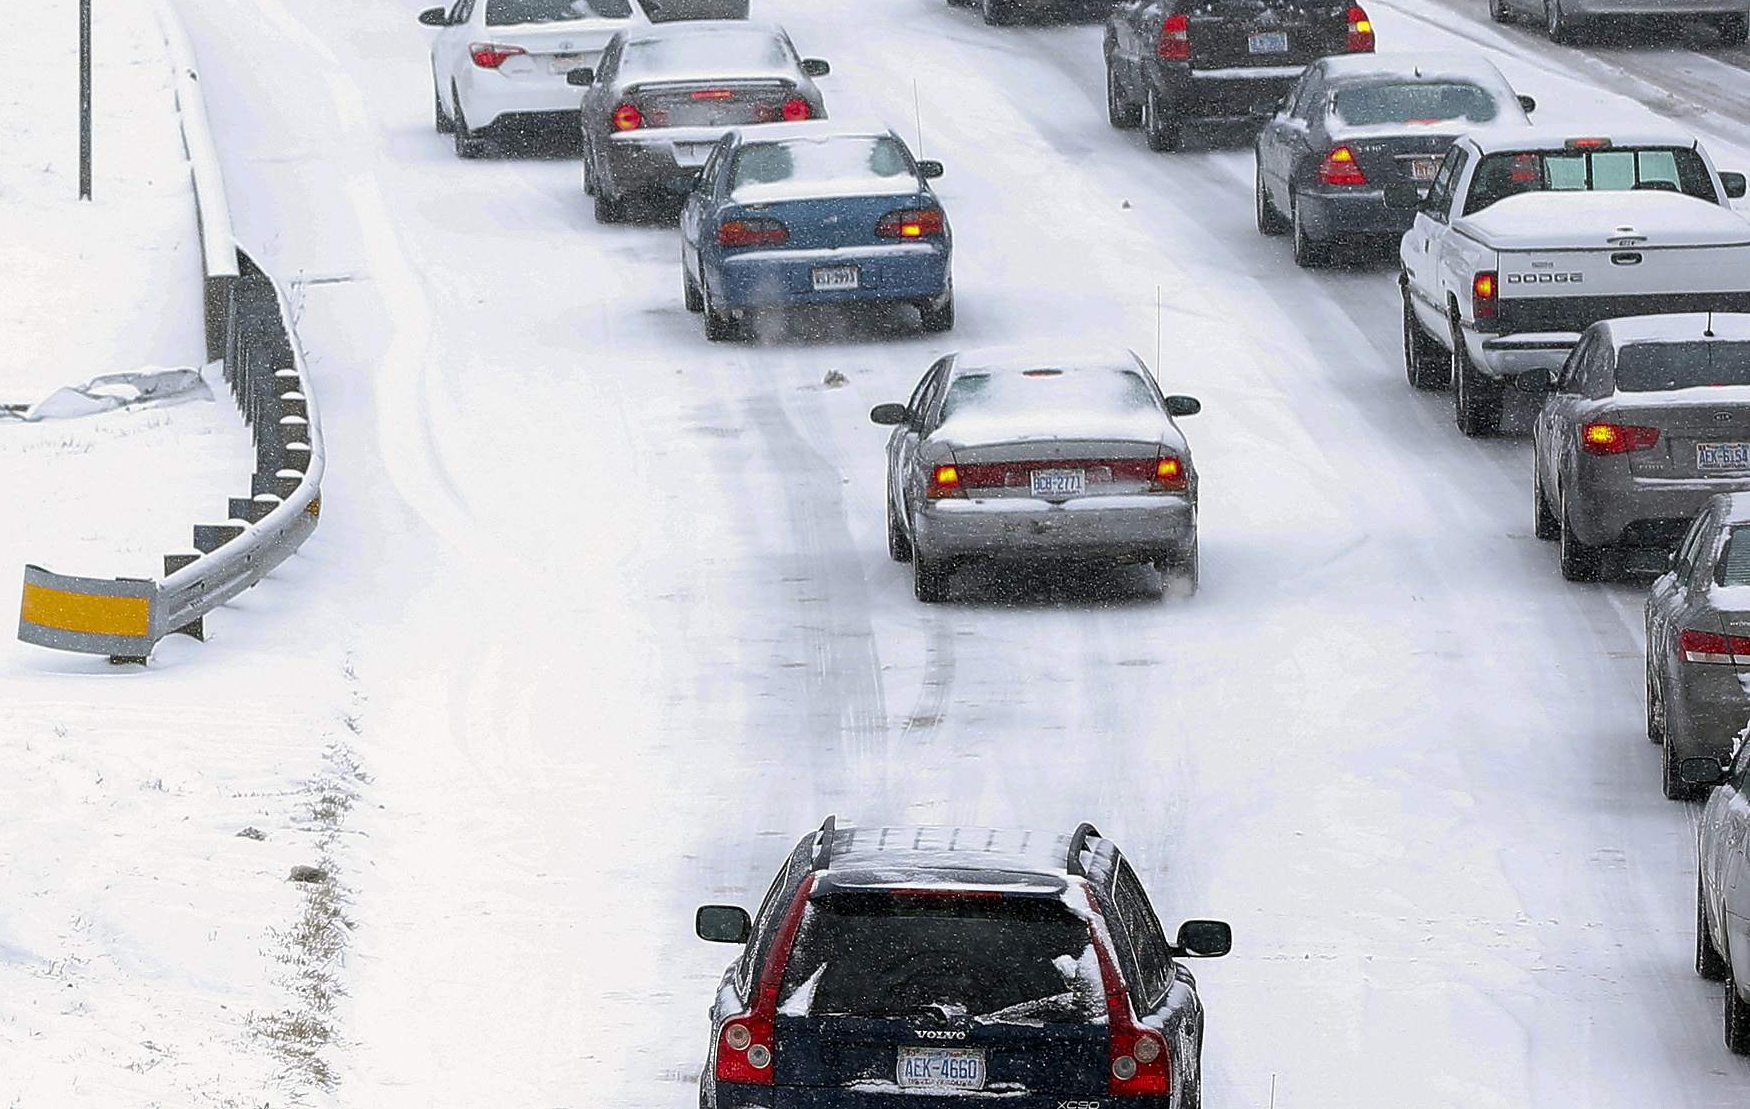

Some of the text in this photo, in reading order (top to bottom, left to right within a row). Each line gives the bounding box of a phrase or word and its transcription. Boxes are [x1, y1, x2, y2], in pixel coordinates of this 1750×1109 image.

[1507, 272, 1584, 284] DODGE
[914, 1029, 967, 1040] VOLVO
[905, 1057, 978, 1079] AEK-4660
[1056, 1099, 1100, 1109] XC90
